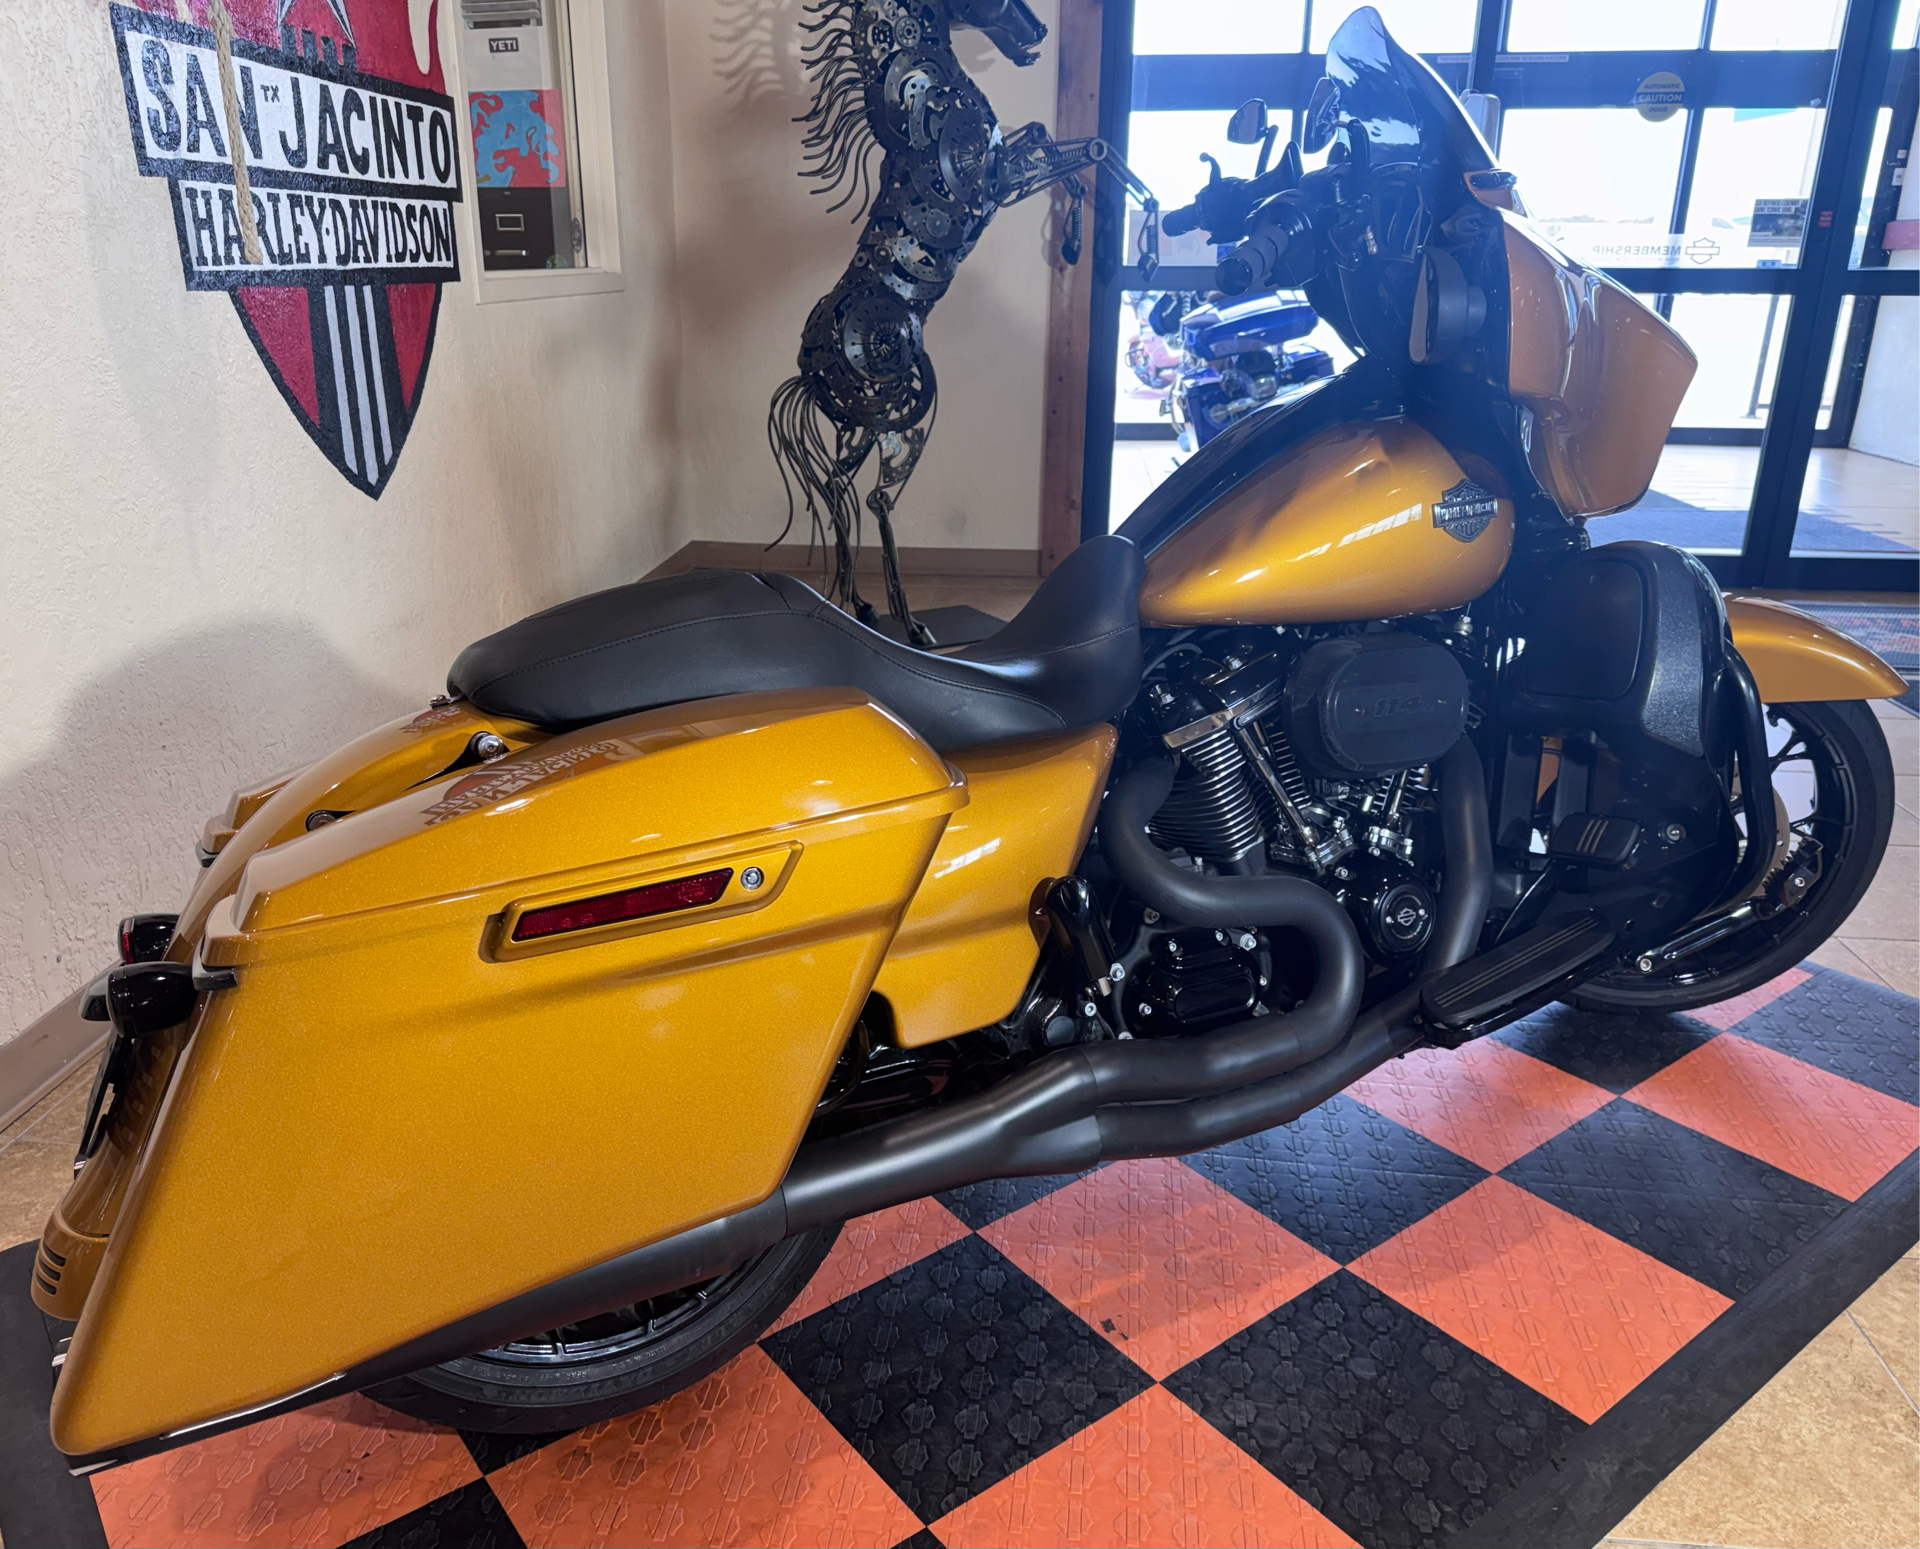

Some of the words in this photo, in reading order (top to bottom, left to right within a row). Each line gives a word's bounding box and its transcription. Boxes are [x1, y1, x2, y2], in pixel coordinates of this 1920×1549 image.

[490, 40, 517, 51] YETI
[1638, 94, 1682, 102] CAUTION
[143, 39, 263, 160] SAN
[260, 84, 280, 103] TX
[279, 76, 451, 184] JACINTO
[1373, 694, 1424, 717] 114
